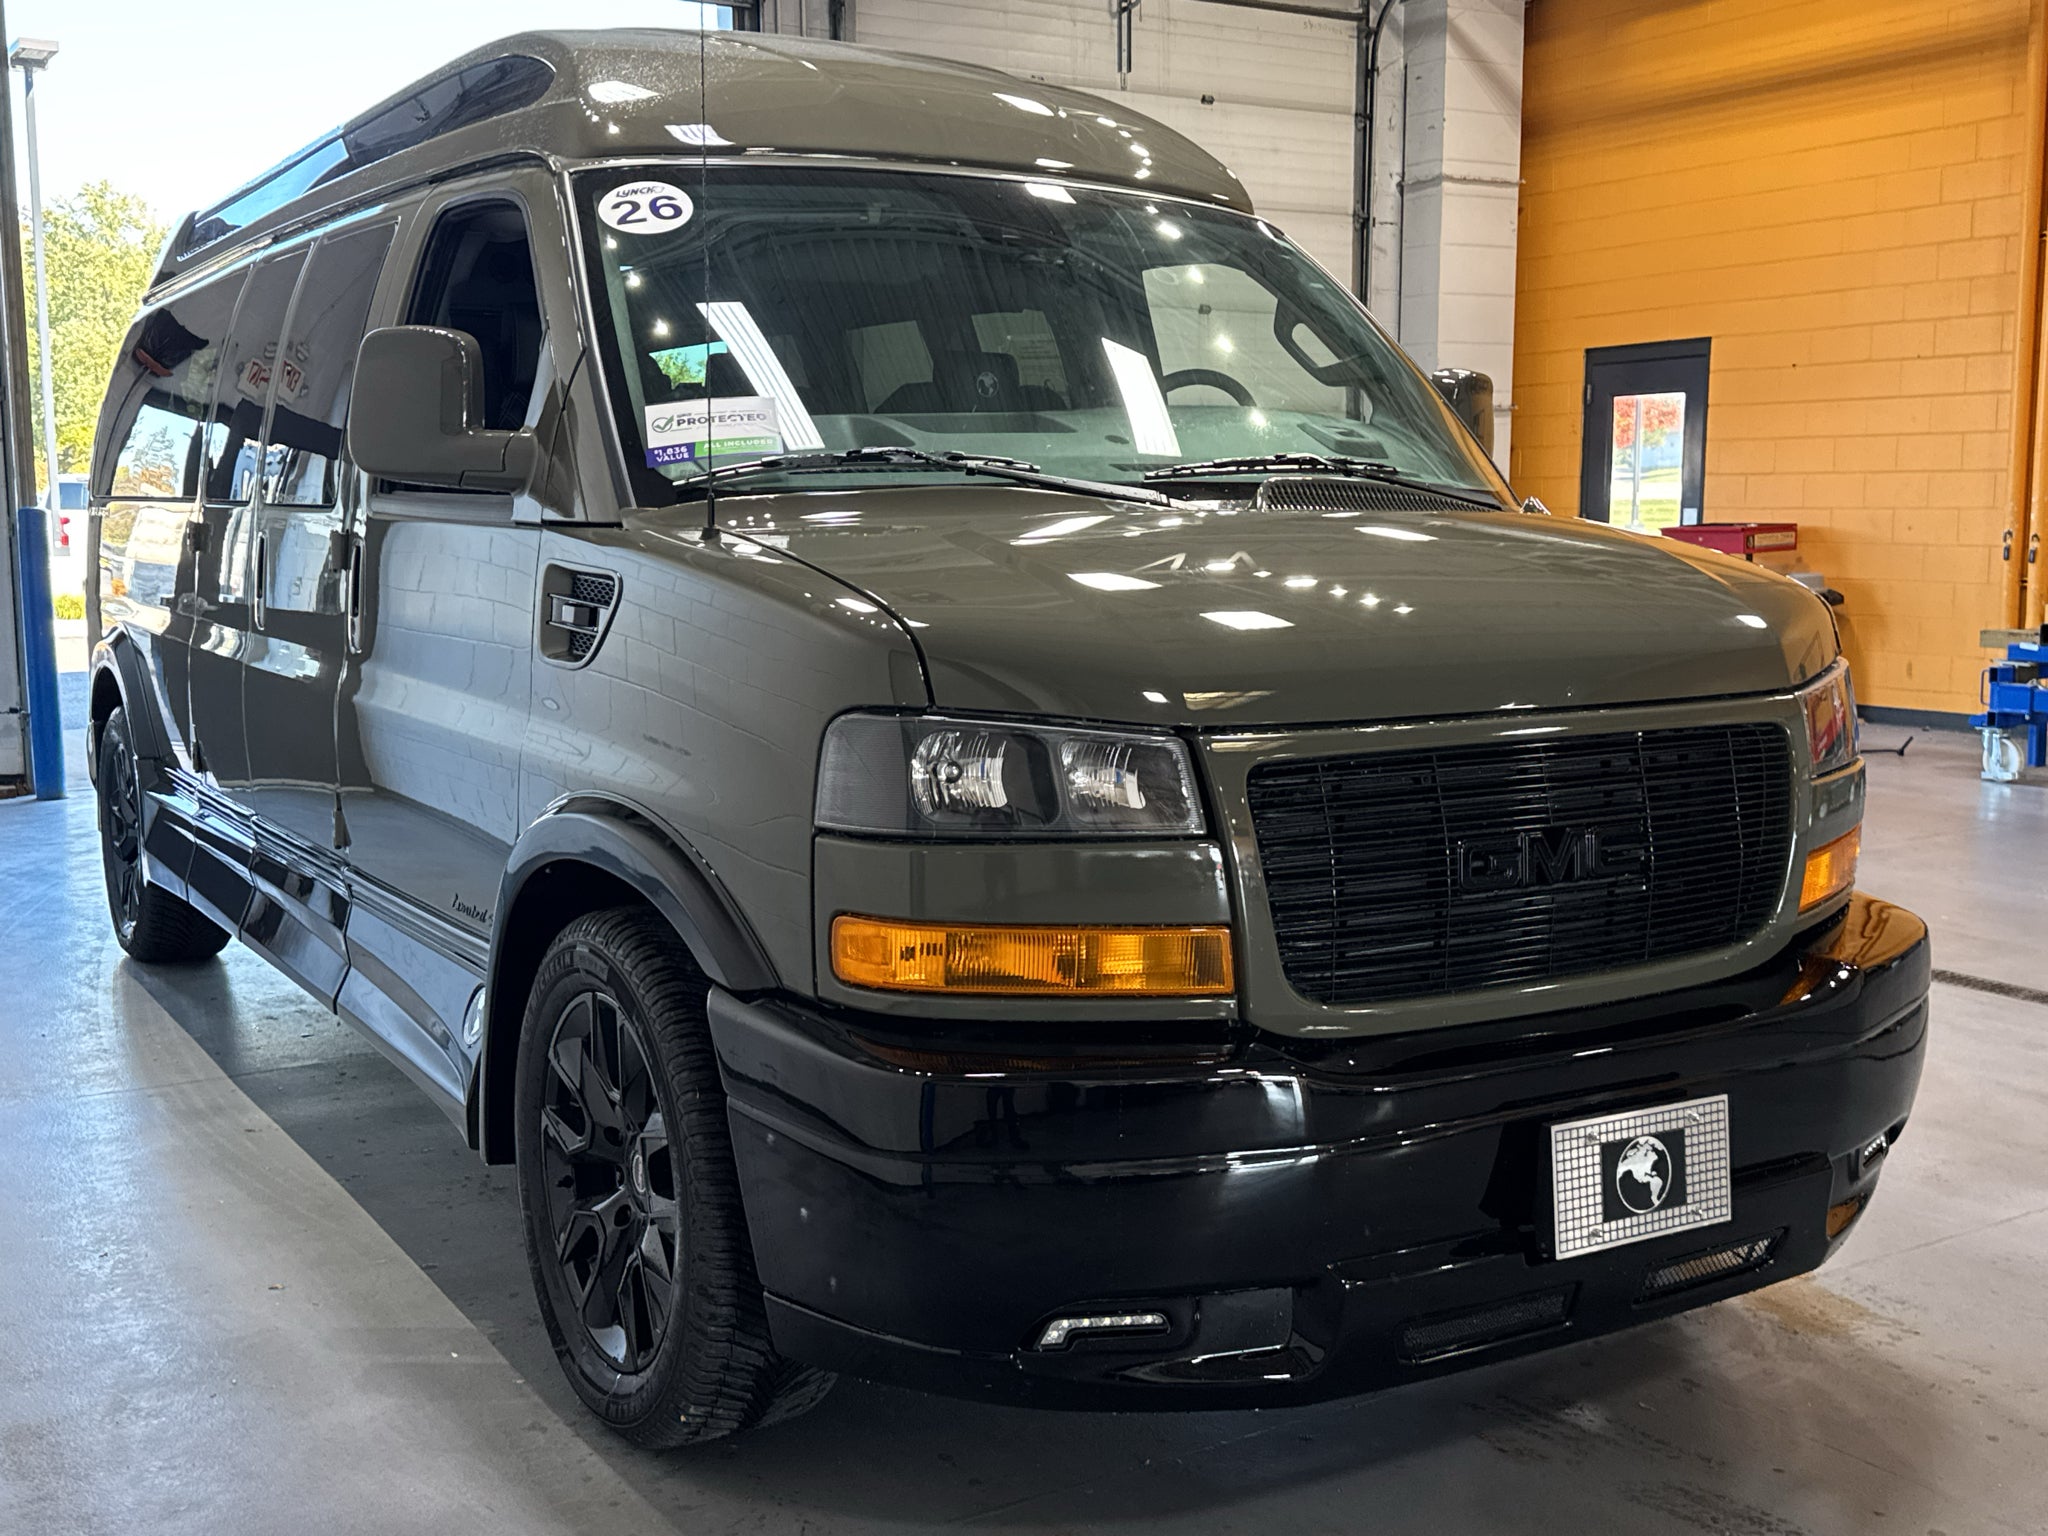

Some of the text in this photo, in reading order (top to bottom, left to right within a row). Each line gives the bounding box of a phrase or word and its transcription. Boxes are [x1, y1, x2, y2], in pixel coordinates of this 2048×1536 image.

[616, 186, 655, 198] LYNCH
[611, 195, 683, 226] 26
[676, 413, 767, 426] PROTECTED
[656, 453, 690, 462] VALUE
[1457, 823, 1646, 890] GMC
